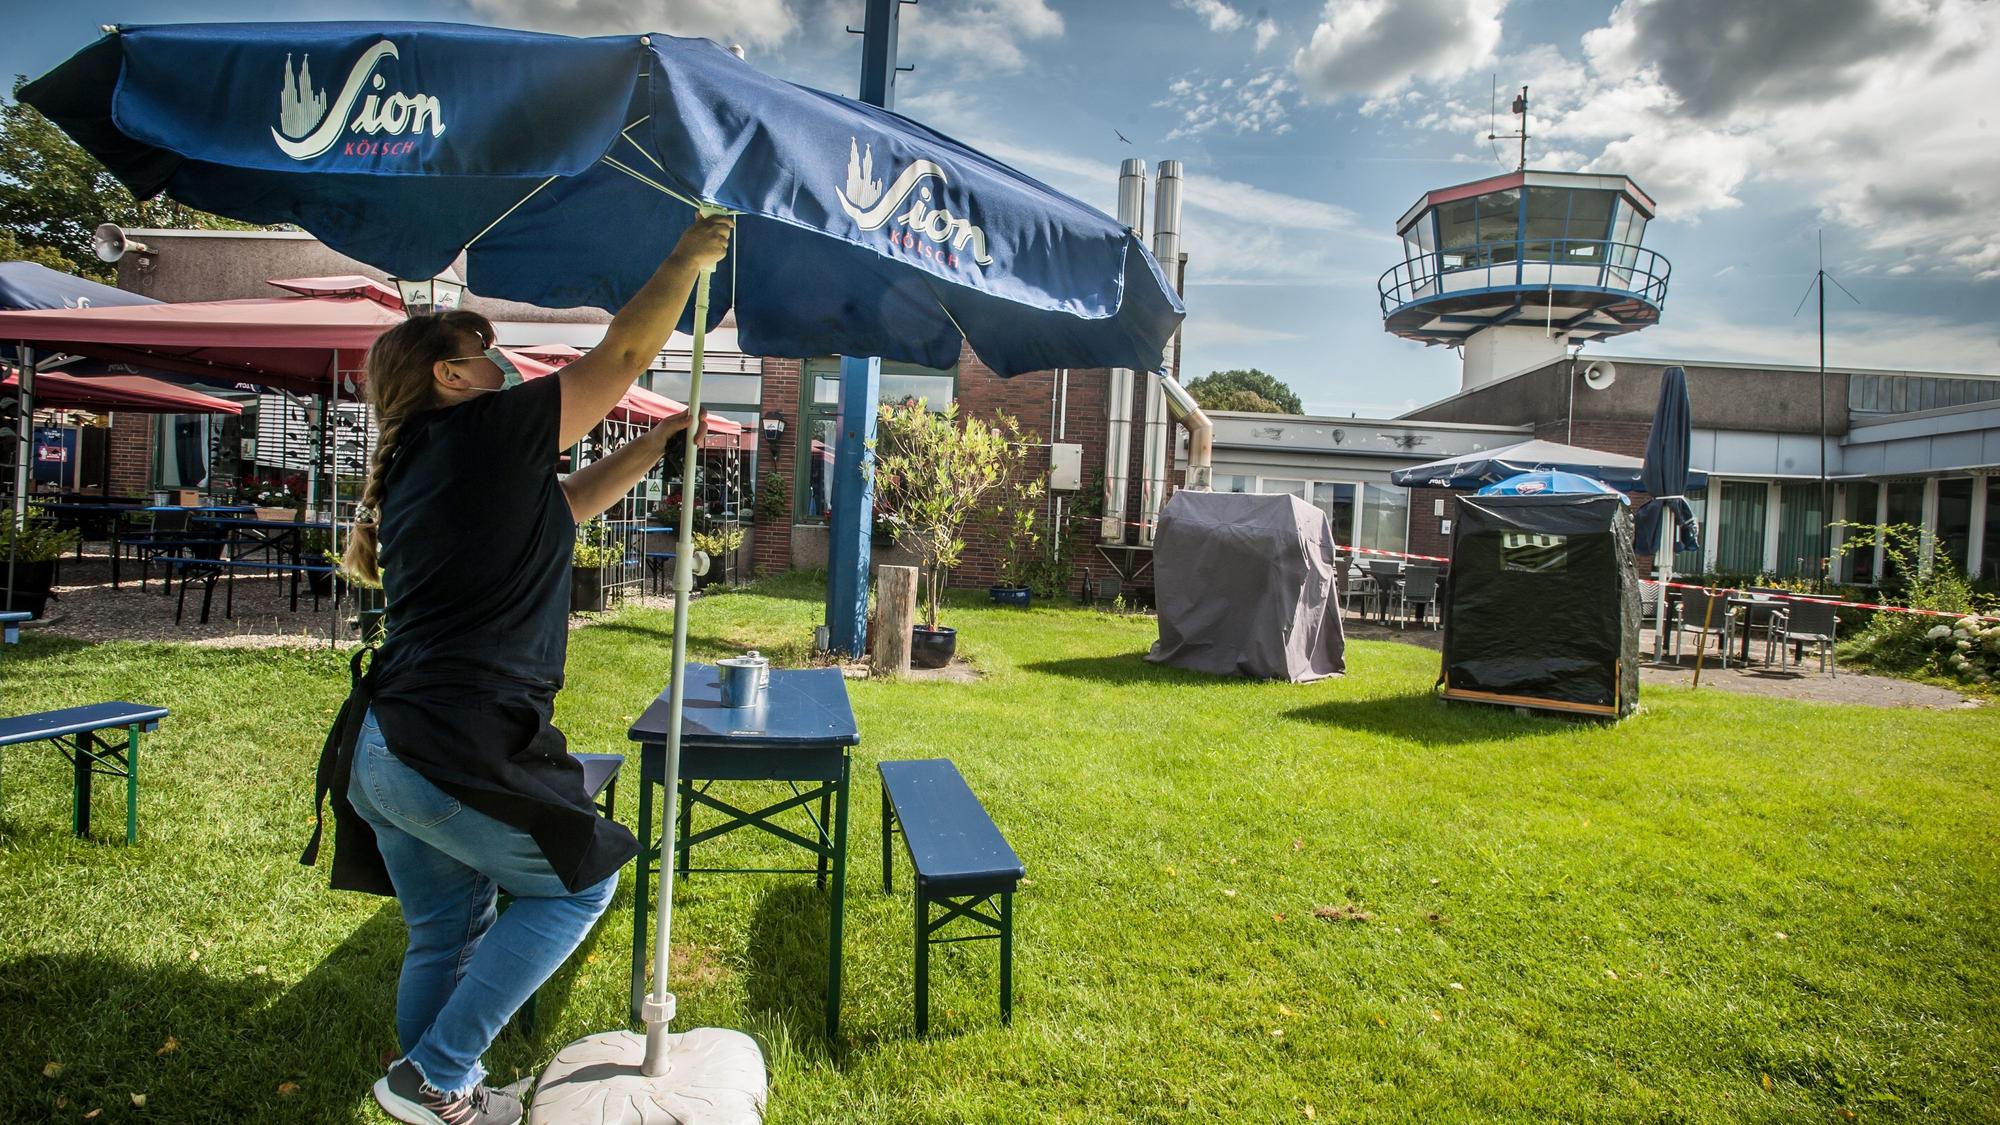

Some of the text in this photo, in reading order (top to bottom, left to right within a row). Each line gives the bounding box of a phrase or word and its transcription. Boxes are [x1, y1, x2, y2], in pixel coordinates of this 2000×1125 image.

[271, 40, 446, 160] Sion
[344, 140, 416, 156] KÖLSCH
[835, 159, 993, 266] Sion
[890, 229, 960, 269] KÖLSCH
